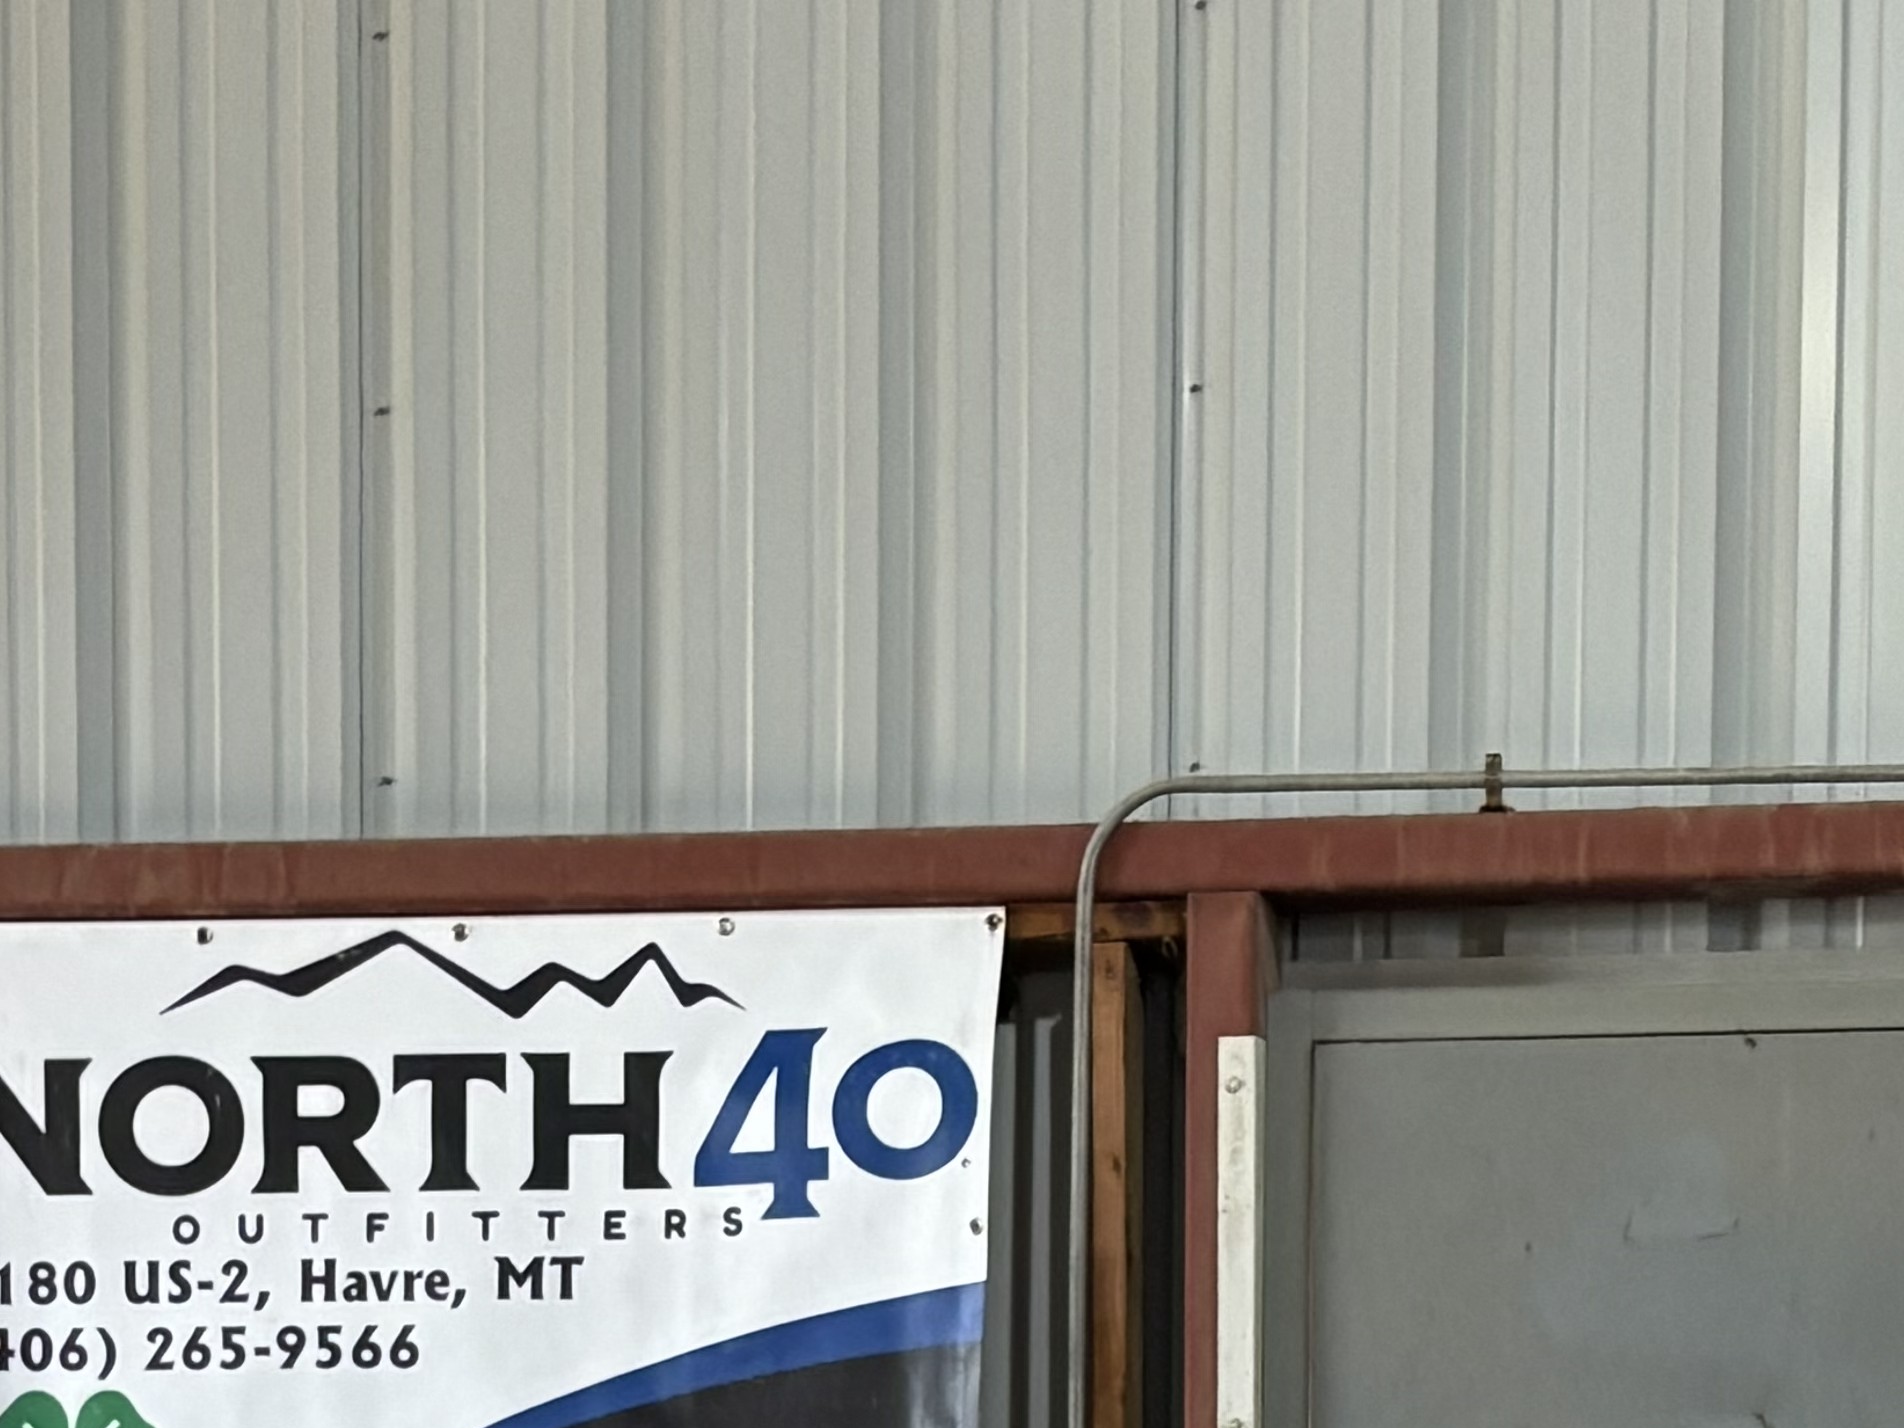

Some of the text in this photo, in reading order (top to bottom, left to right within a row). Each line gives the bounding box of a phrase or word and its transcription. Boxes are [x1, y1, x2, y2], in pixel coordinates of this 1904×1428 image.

[694, 1027, 978, 1226] 40
[173, 1207, 742, 1245] OUTFITTERS
[124, 1259, 270, 1311] US-2,
[301, 1258, 466, 1309] Havre,
[494, 1256, 584, 1300] MT
[145, 1325, 419, 1370] 265-9566
